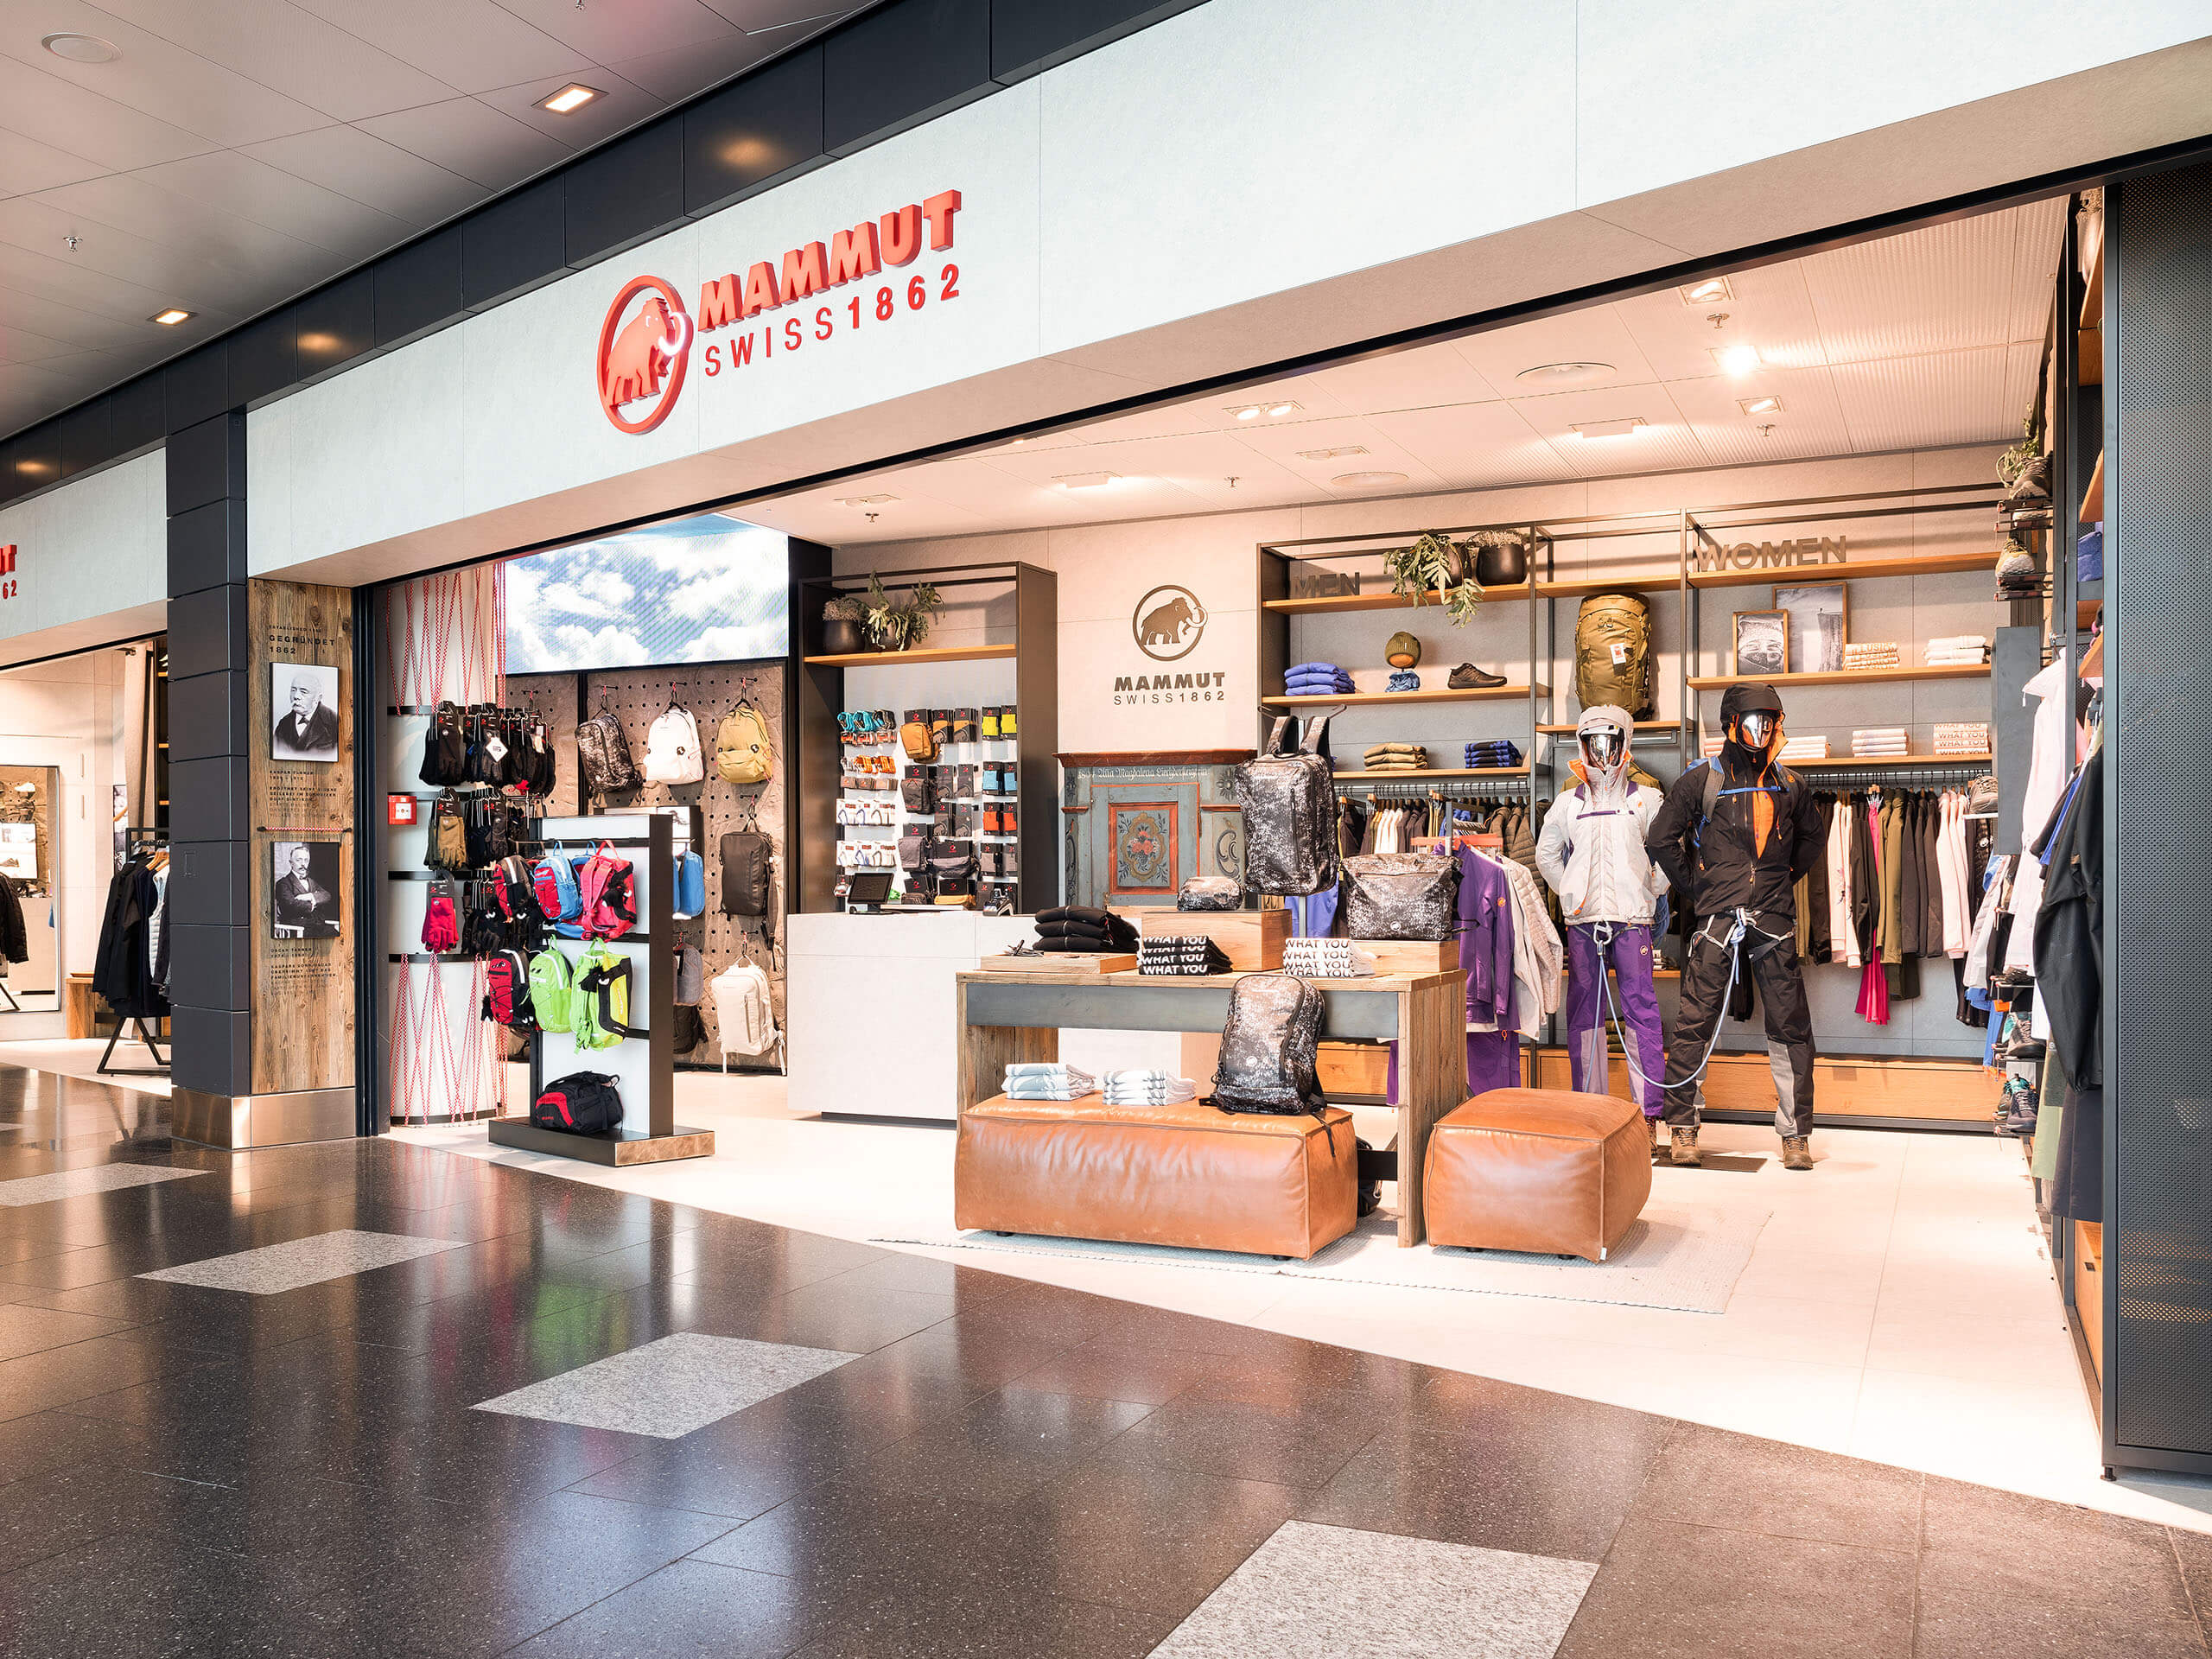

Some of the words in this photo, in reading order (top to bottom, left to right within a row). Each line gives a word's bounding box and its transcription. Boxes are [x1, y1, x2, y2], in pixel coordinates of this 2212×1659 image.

[698, 189, 962, 333] MAMMUT
[1695, 535, 1847, 572] WOMEN
[1291, 571, 1361, 600] MEN
[269, 634, 335, 646] GEGRÜNDET
[269, 645, 296, 654] 1862
[1114, 671, 1225, 692] MAMMUT
[1143, 935, 1179, 945] WHAT
[1182, 935, 1206, 945] YOU
[1285, 939, 1320, 949] WHAT
[1325, 939, 1349, 949] YOU
[1141, 955, 1176, 965] WHAT
[1179, 953, 1205, 963] YOU
[1282, 951, 1318, 960] WHAT
[1143, 964, 1179, 976] WHAT
[1182, 964, 1209, 975] YOU
[1284, 968, 1320, 977] WHAT
[1325, 969, 1351, 978] YOU
